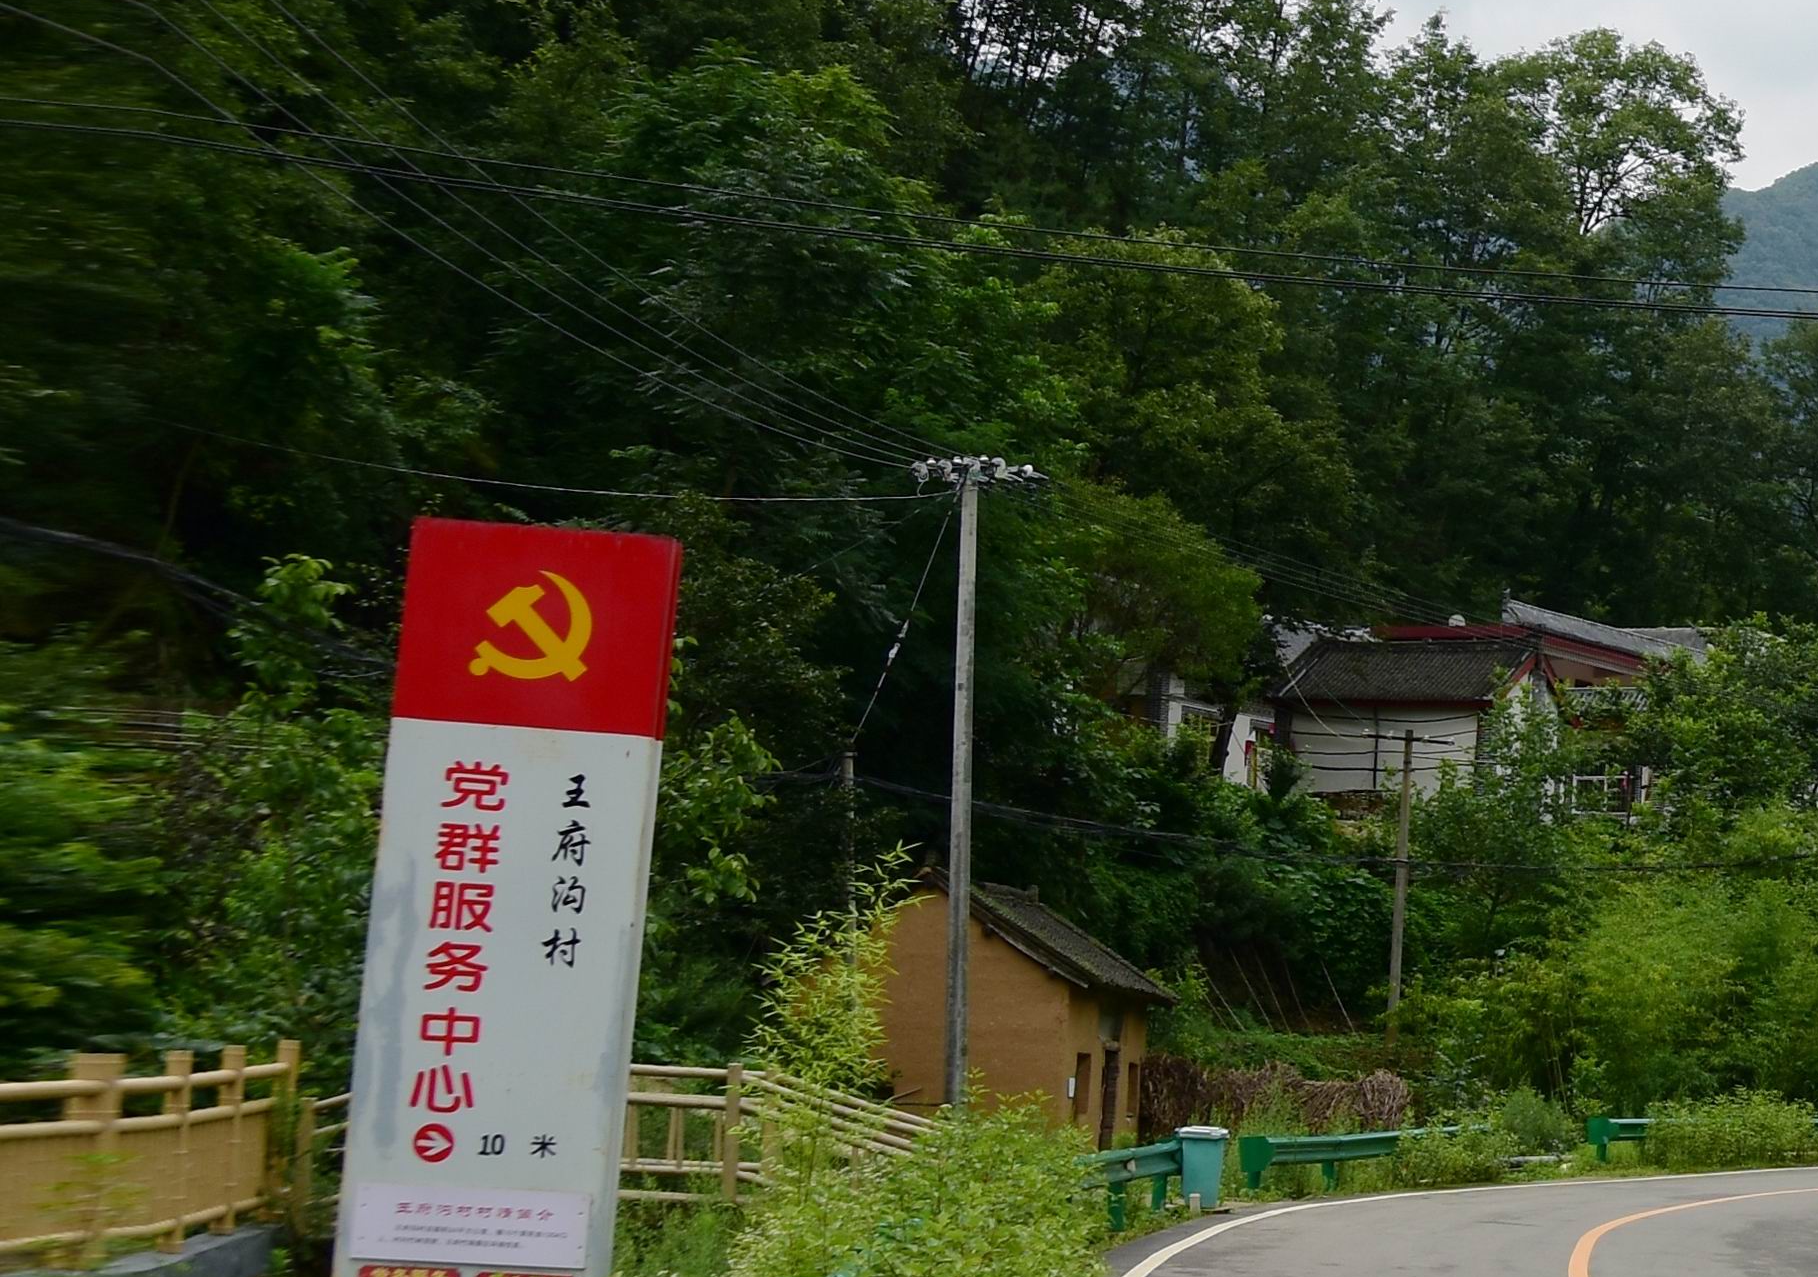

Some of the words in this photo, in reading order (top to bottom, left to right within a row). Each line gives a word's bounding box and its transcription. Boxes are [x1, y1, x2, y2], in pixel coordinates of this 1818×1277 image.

[409, 760, 509, 1114] 党群服务中心
[541, 773, 591, 968] 王府沟村
[478, 1134, 505, 1156] 10
[530, 1134, 557, 1159] 米
